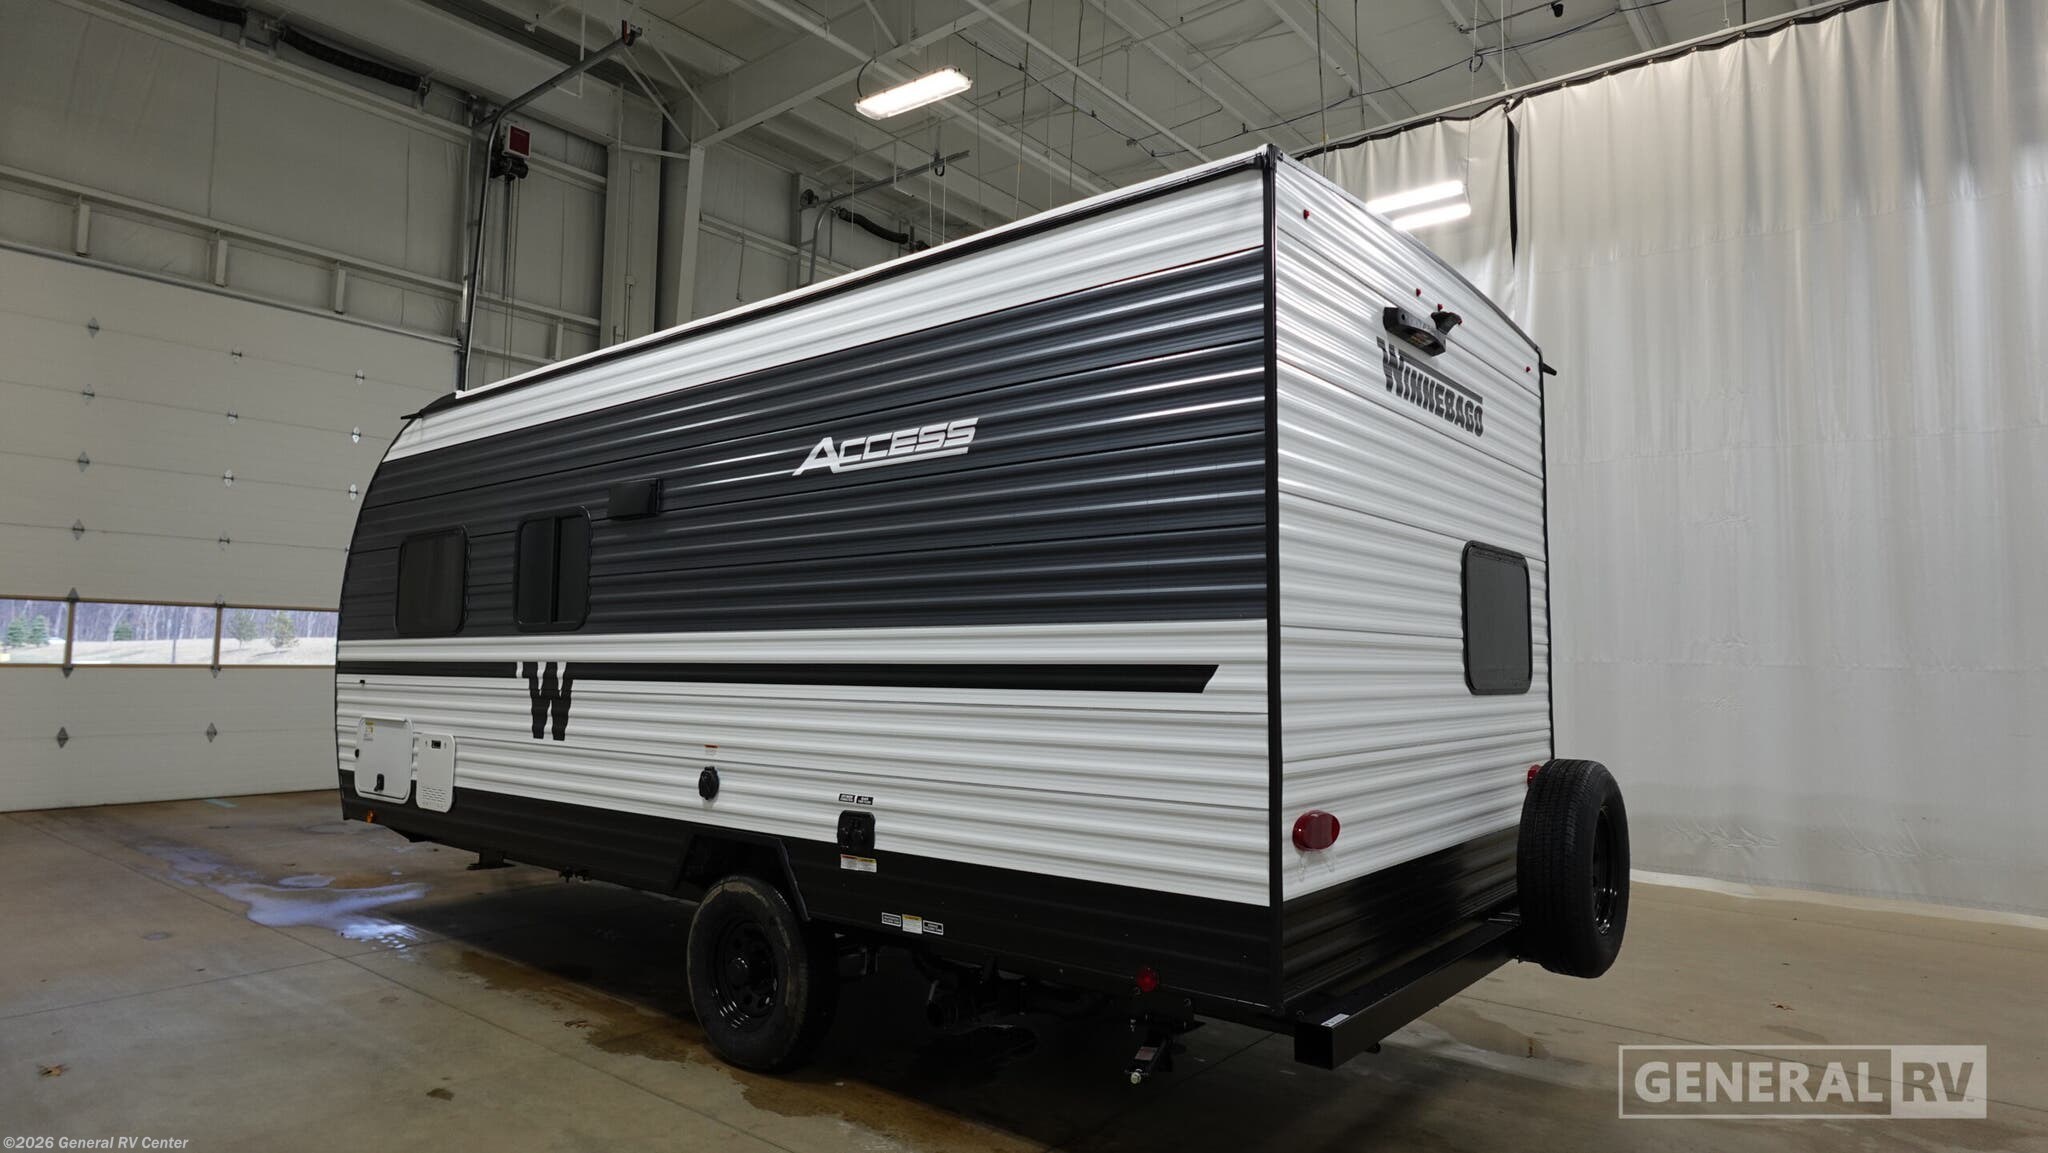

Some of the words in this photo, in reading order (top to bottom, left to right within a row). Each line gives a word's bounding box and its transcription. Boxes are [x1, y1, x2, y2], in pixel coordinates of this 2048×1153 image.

[1376, 336, 1483, 437] WINNEBAGO
[792, 417, 979, 476] ACCESS
[522, 661, 573, 741] W
